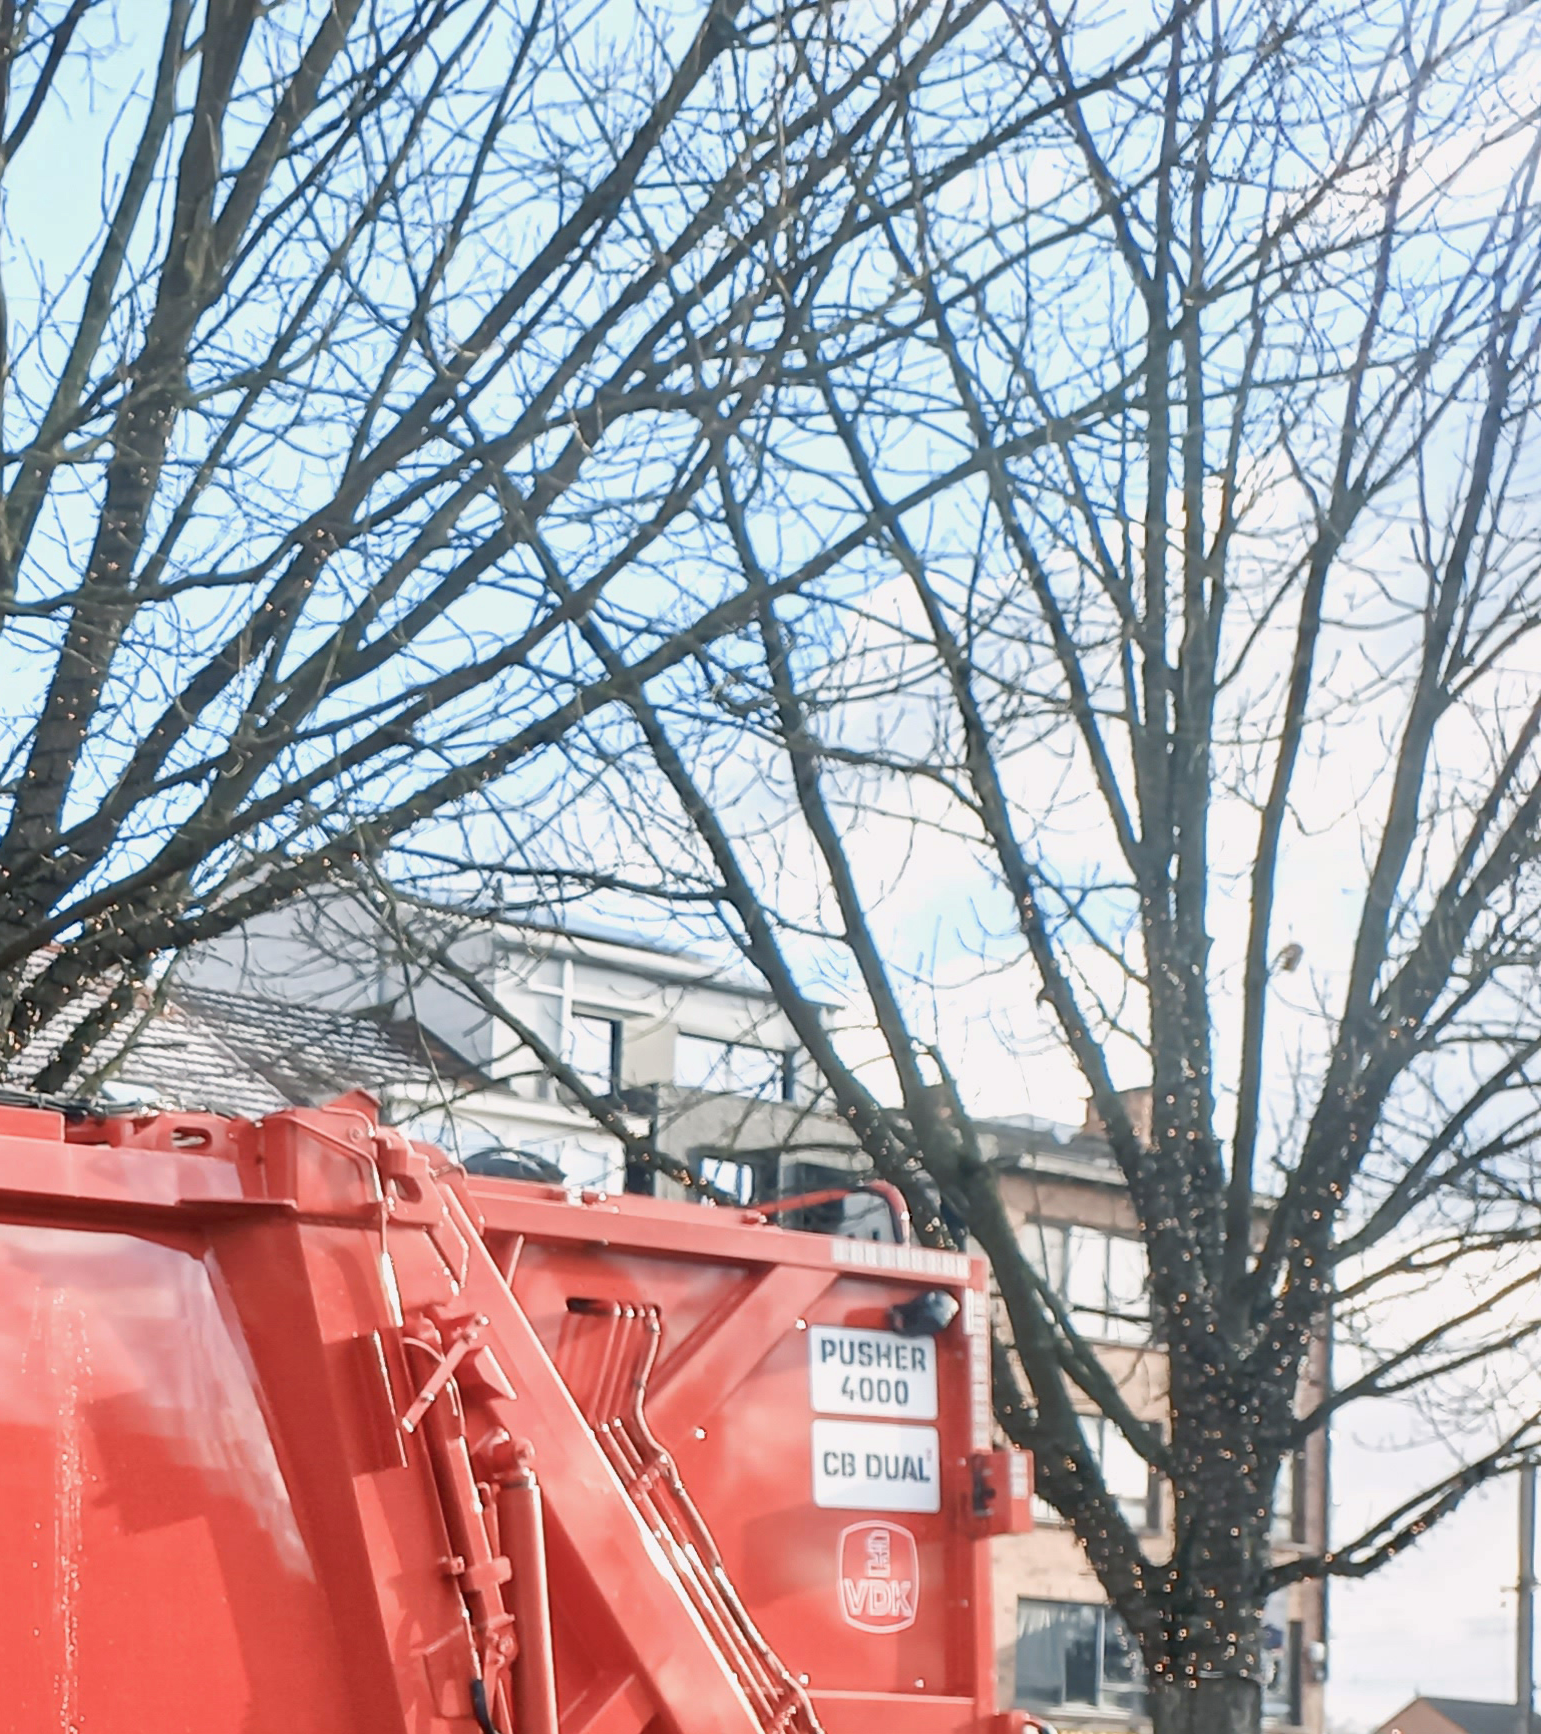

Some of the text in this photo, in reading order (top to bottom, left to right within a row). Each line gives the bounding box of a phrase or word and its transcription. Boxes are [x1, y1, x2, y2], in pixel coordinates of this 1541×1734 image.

[821, 1338, 926, 1371] PUSHER
[841, 1375, 909, 1406] 4000
[823, 1451, 931, 1482] CB DUAL
[843, 1578, 913, 1616] VDK
